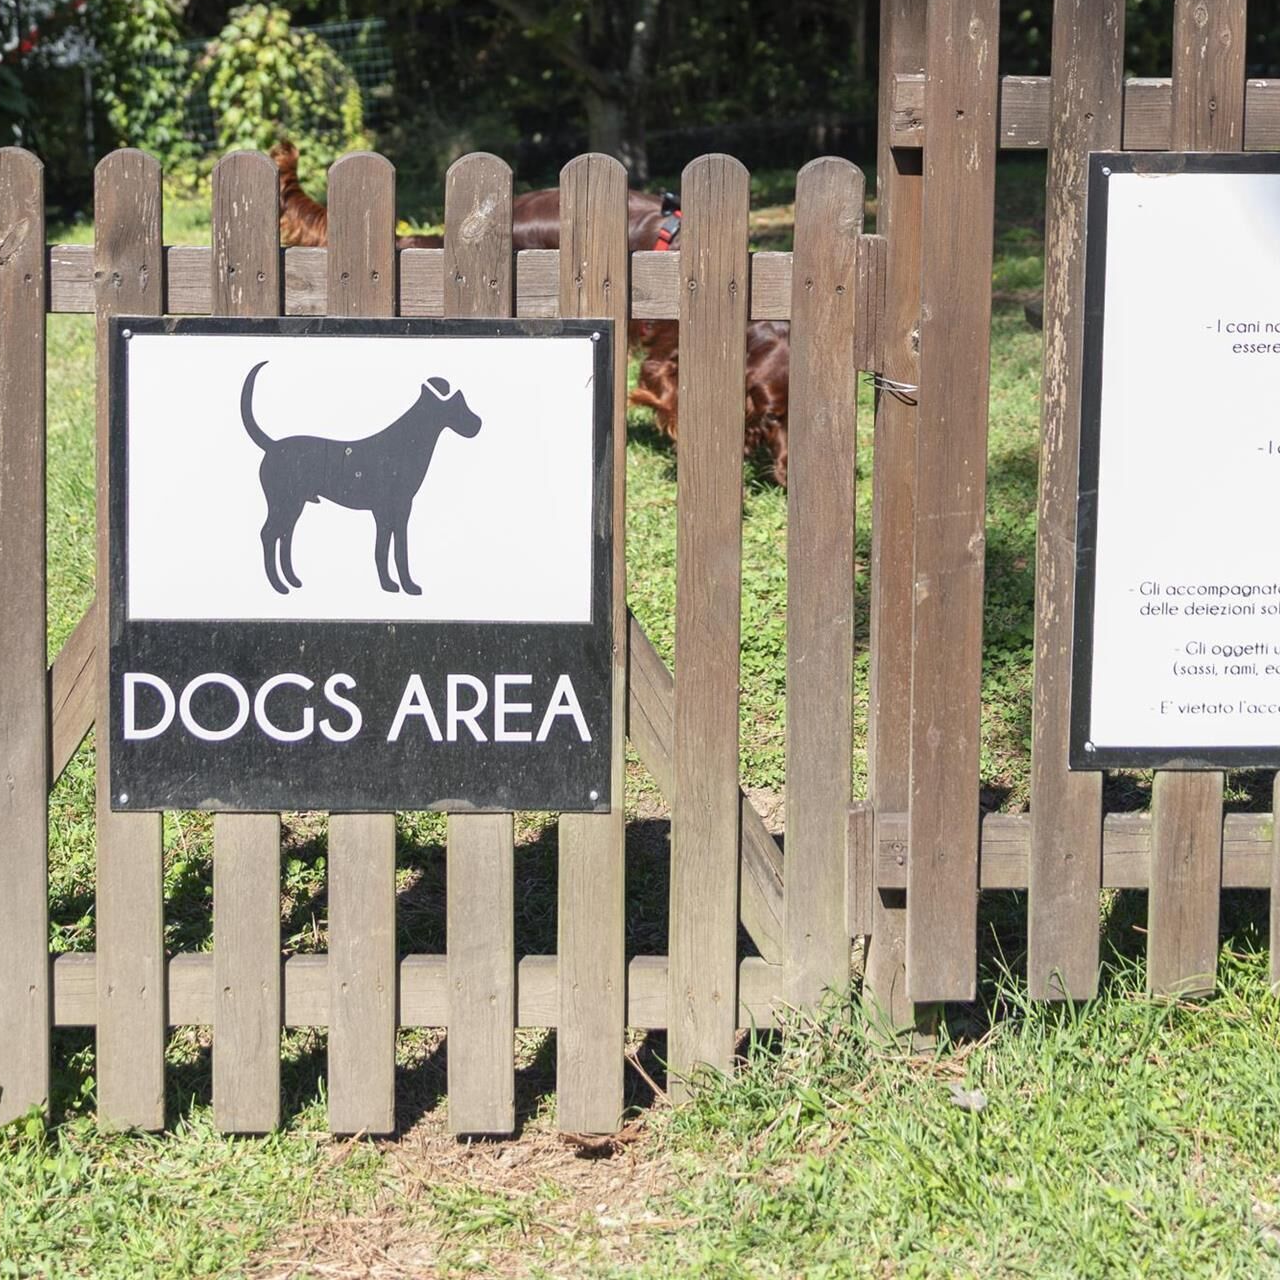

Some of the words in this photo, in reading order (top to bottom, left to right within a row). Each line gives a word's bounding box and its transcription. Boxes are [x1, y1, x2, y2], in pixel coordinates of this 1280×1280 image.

[1217, 319, 1221, 333] I
[1226, 320, 1260, 333] cani
[1269, 440, 1272, 455] I
[1139, 581, 1160, 596] Gli
[1139, 601, 1179, 616] delle
[1184, 601, 1255, 616] deiezioni
[1185, 641, 1206, 656] Gli
[1211, 642, 1268, 658] oggetti
[1173, 661, 1219, 678] (sassi,
[1224, 662, 1259, 677] rami,
[123, 672, 363, 742] DOGS
[387, 674, 593, 742] AREA
[1178, 701, 1234, 714] vietato
